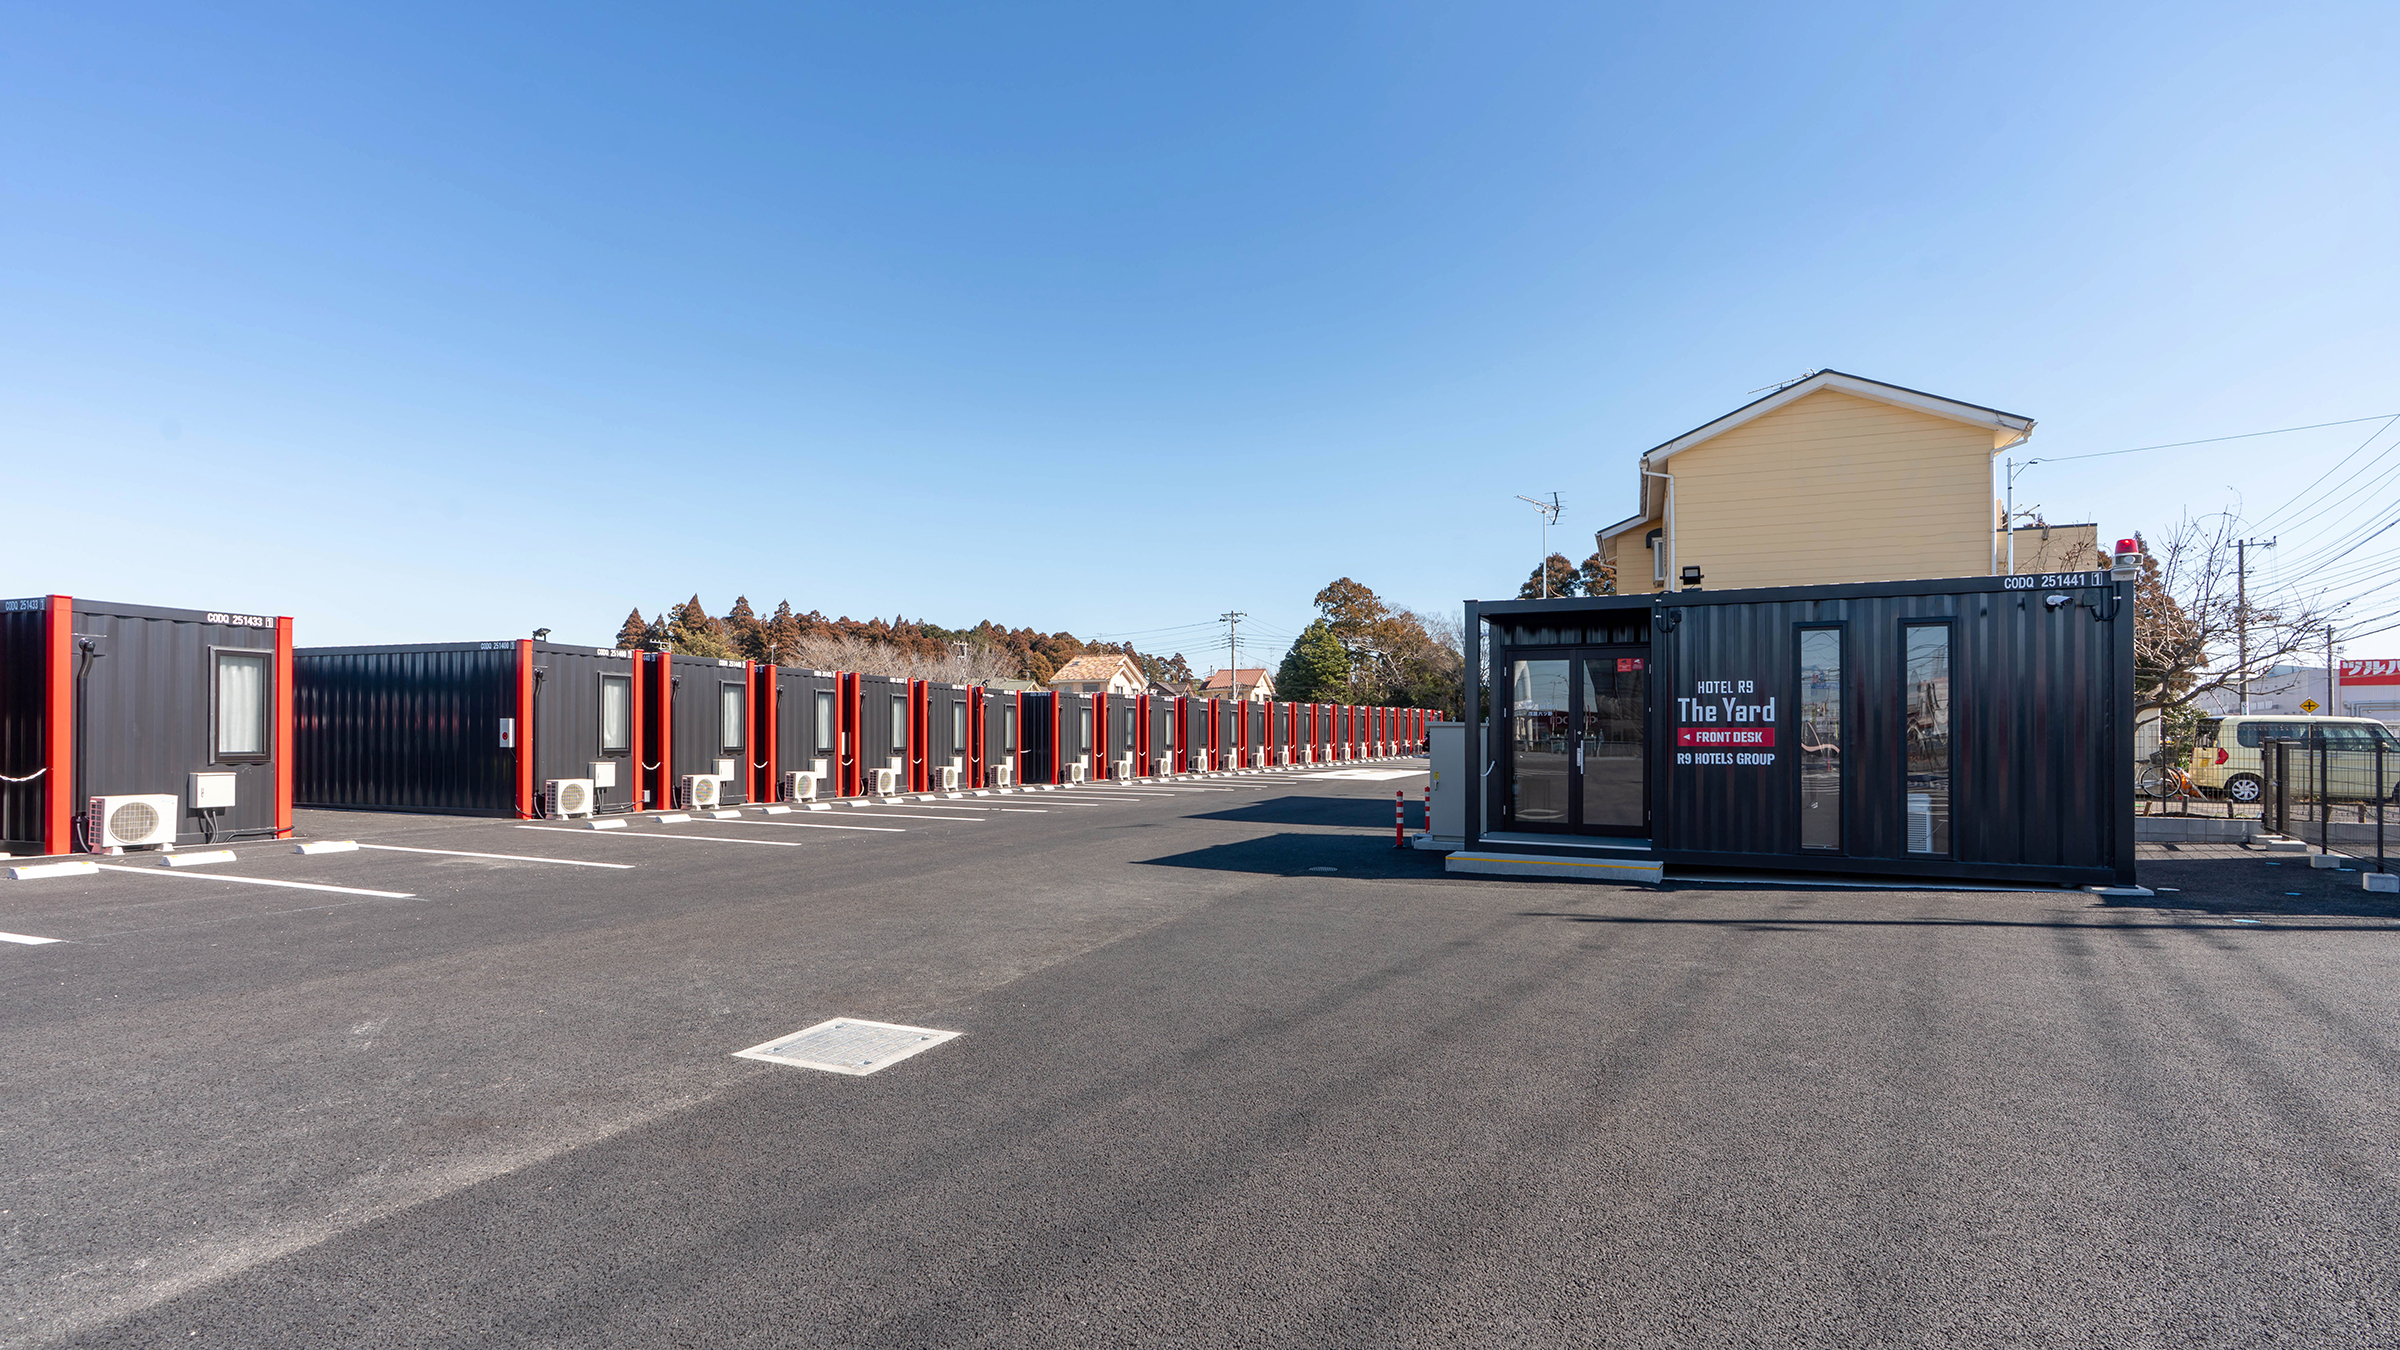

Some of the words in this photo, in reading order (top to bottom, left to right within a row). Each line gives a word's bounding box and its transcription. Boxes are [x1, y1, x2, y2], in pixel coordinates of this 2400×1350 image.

[2004, 577, 2034, 589] CODQ
[2041, 574, 2084, 588] 251441
[207, 612, 230, 624] CODQ
[232, 615, 263, 627] 251433
[1697, 681, 1733, 694] HOTEL
[1738, 680, 1754, 694] R9
[1677, 697, 1717, 722] The
[1722, 697, 1775, 722] Yard
[1696, 732, 1731, 743] FRONT
[1733, 732, 1762, 743] DESK
[1677, 753, 1692, 765] R9
[1695, 753, 1733, 765] HOTELS
[1736, 753, 1775, 766] GROUP
